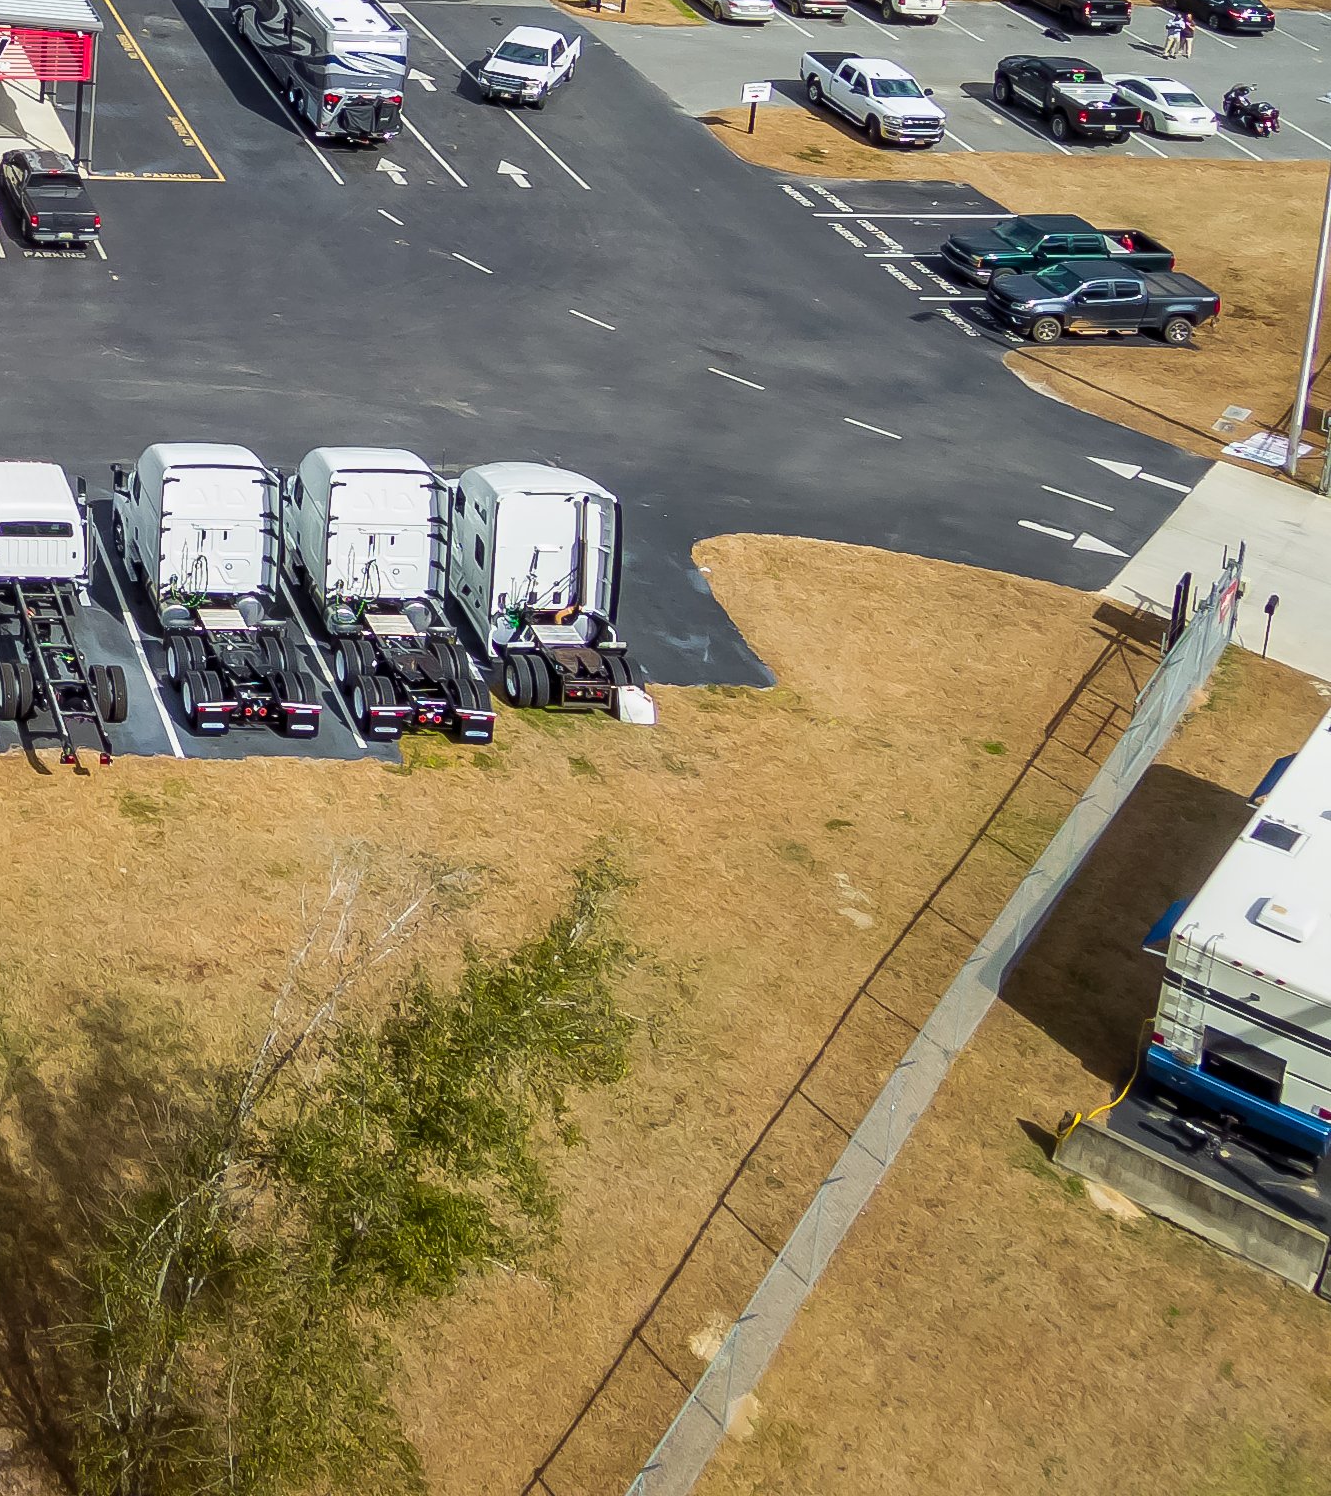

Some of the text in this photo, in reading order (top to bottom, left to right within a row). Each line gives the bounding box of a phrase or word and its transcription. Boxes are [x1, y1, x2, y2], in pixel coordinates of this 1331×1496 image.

[777, 184, 816, 208] PARKING
[807, 183, 854, 213] CUSTOMER
[826, 222, 868, 248] PARKING
[856, 218, 905, 254] CUSTOMER
[23, 250, 87, 259] PARKING
[879, 262, 923, 291] PARKING
[935, 307, 981, 337] PARKING
